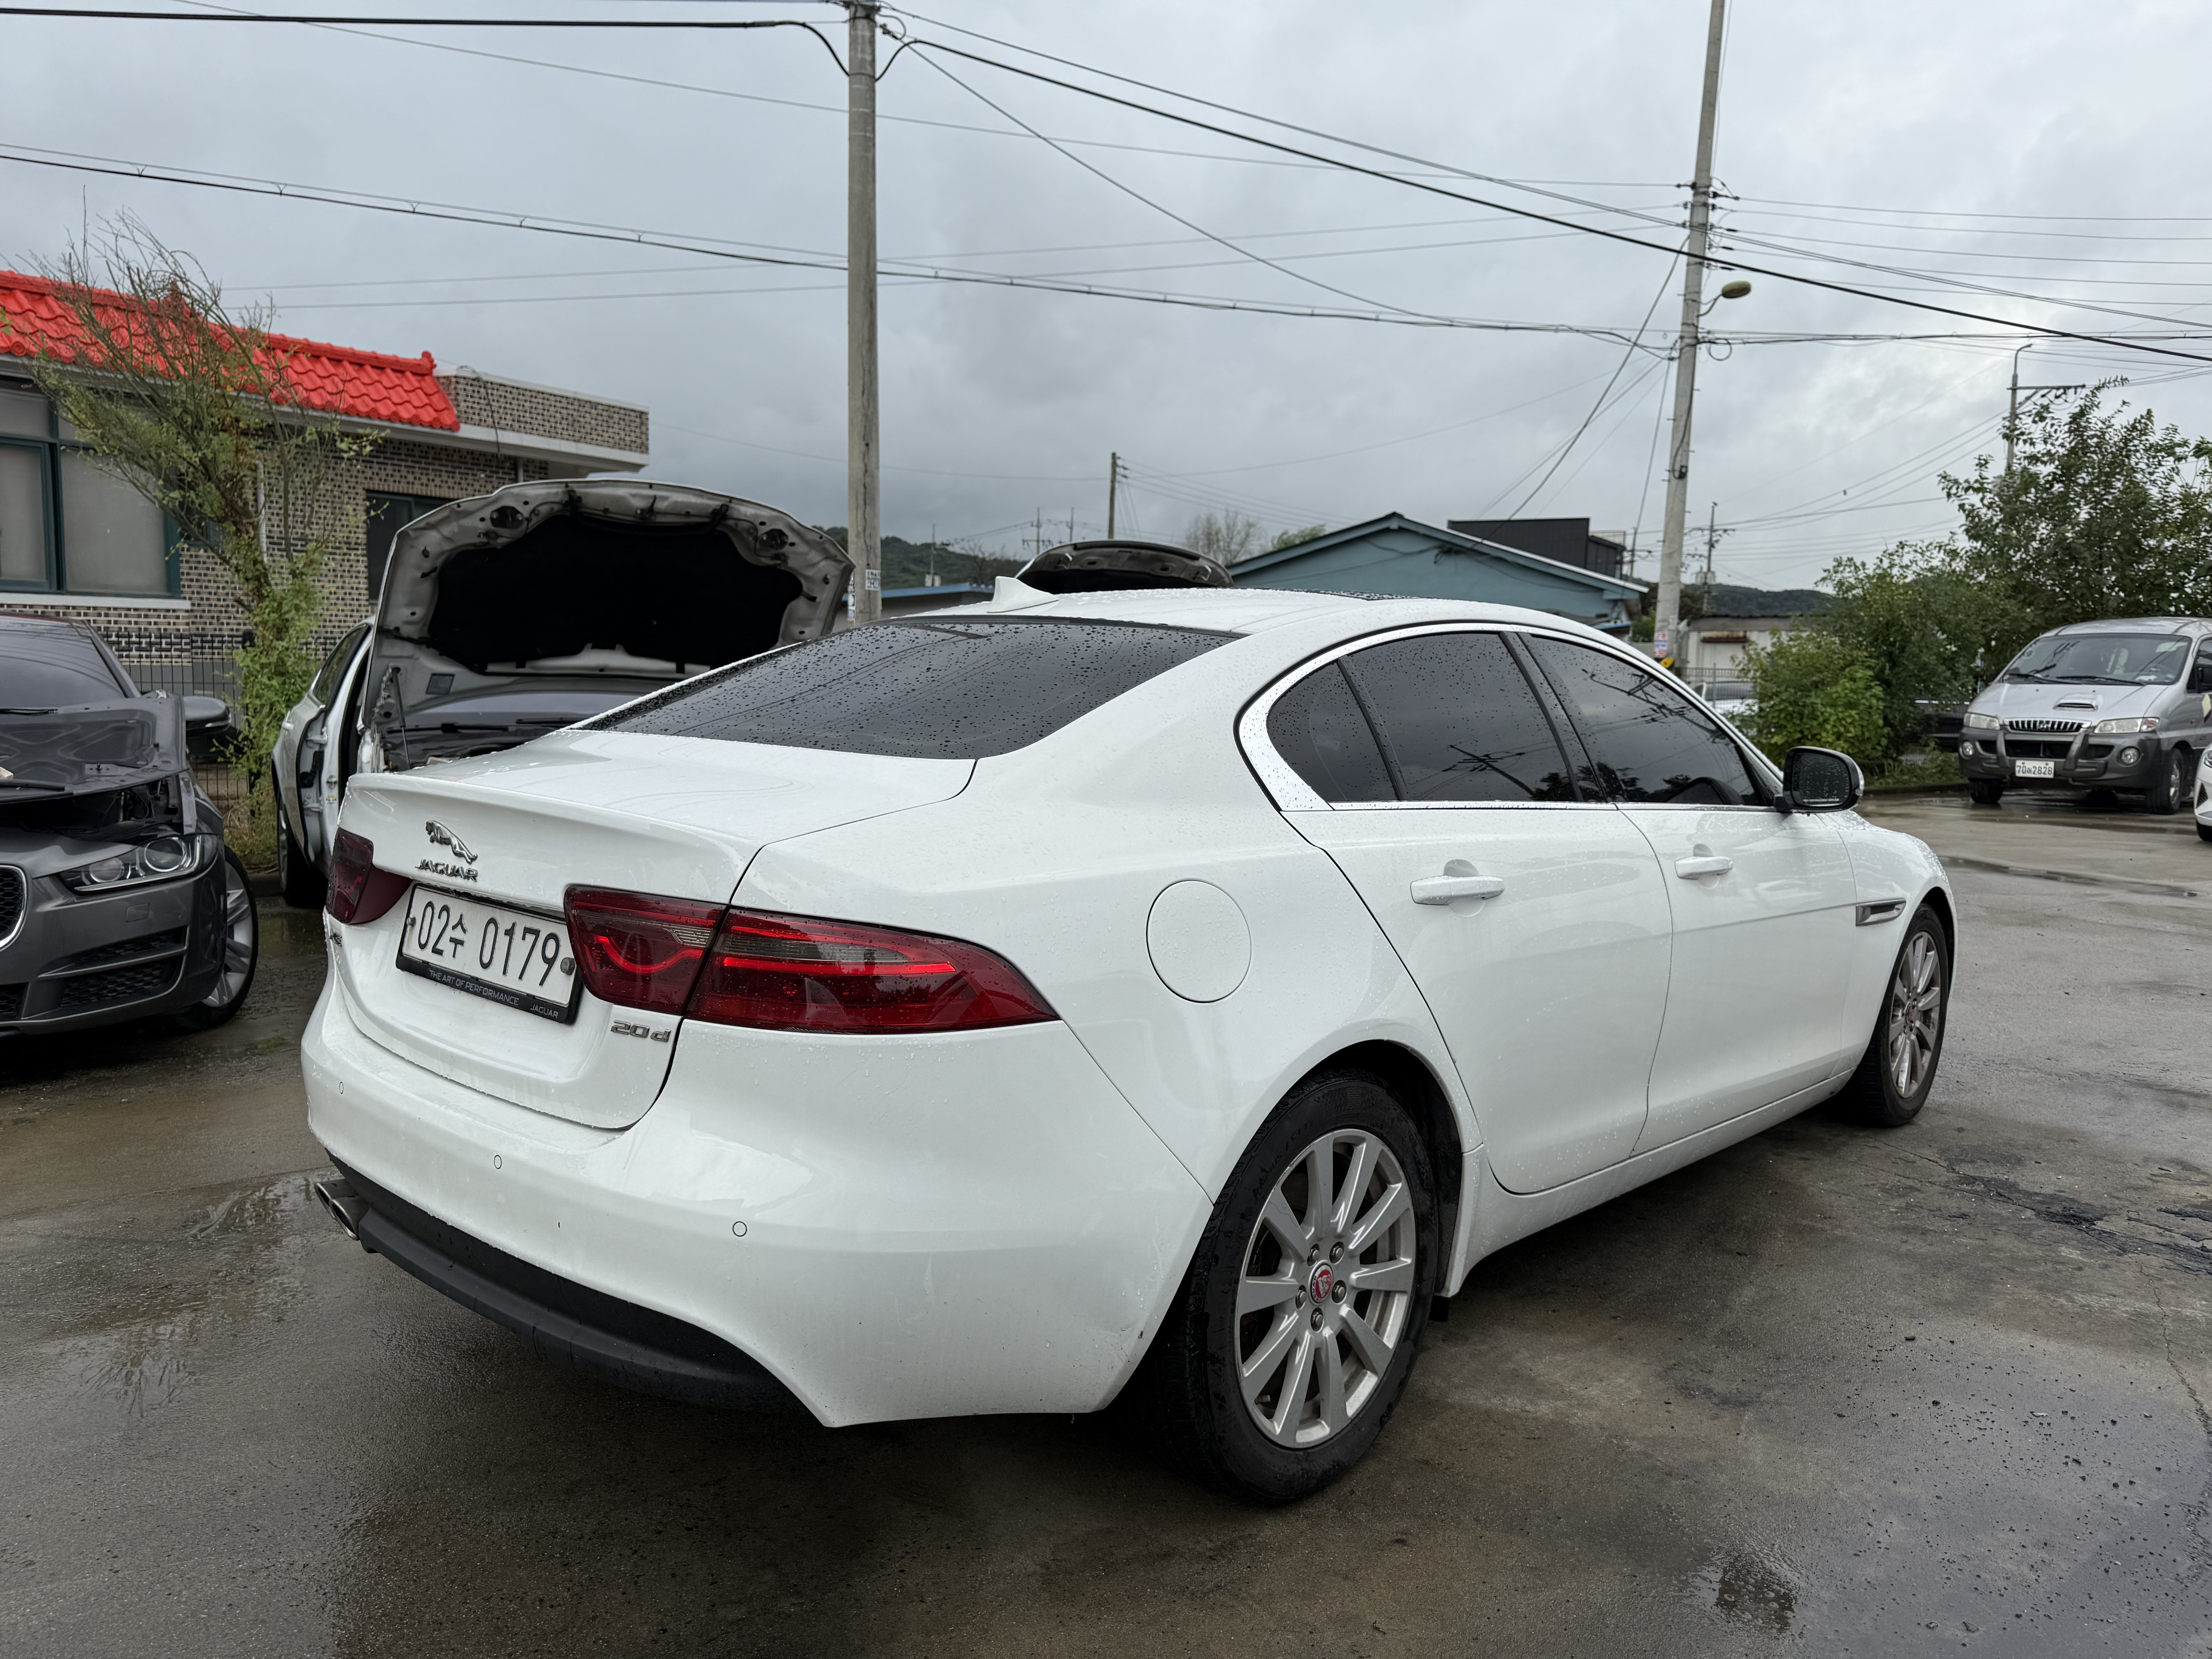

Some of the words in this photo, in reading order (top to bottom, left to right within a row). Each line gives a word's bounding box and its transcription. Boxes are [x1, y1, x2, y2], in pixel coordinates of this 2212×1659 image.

[415, 859, 478, 882] JAGUAR
[418, 901, 468, 958] 02수
[479, 917, 561, 986] 0179
[429, 970, 441, 980] THE
[442, 975, 455, 985] ART
[455, 979, 465, 988] OF
[465, 982, 519, 1006] PERFORMANCE
[530, 1004, 559, 1018] JAGUAR
